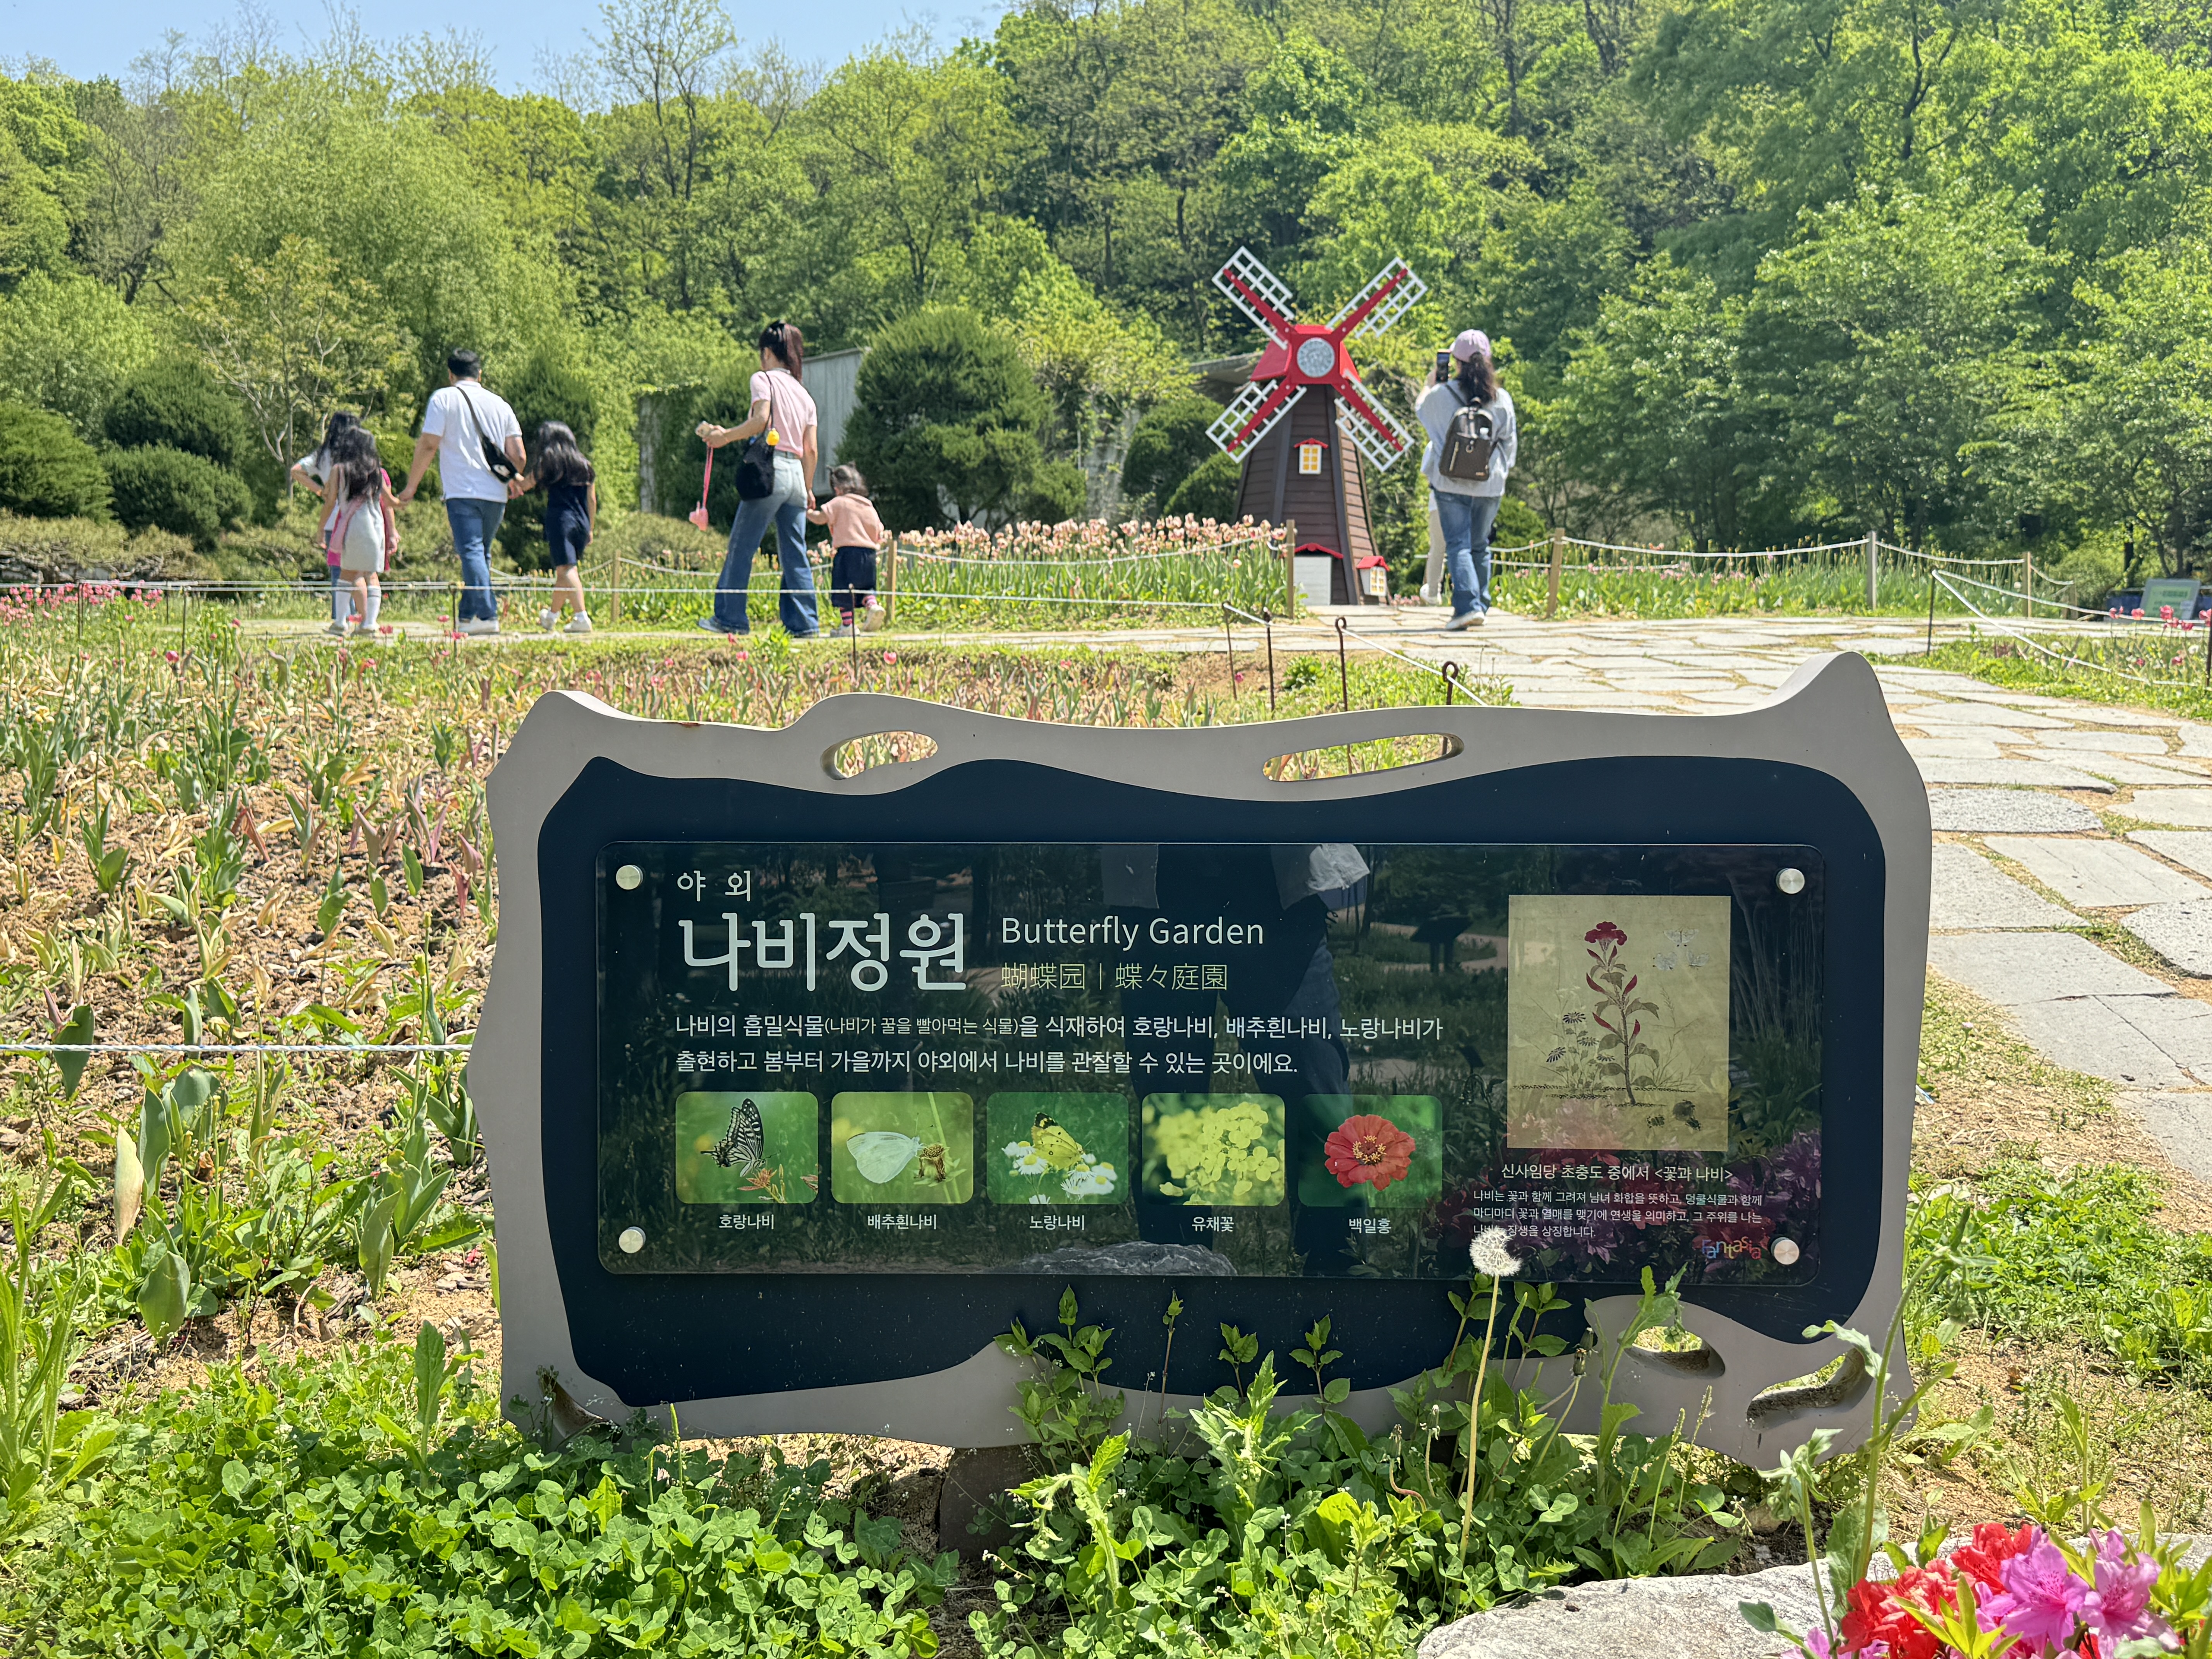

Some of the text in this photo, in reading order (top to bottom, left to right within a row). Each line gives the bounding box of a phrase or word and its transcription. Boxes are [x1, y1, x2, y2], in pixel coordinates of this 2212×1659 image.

[1003, 915, 1263, 951] Butterfly Garden
[678, 912, 967, 991] 나비정원
[677, 1015, 735, 1037] 나비의
[881, 1018, 912, 1034] 꿀을
[917, 1017, 978, 1034] 빨아먹는
[1046, 1015, 1124, 1038] 식재하여
[1132, 1016, 1218, 1039] 호랑나비,
[1225, 1015, 1331, 1039] 배추흰나비,
[1340, 1017, 1443, 1040] 노랑나비가
[676, 1050, 1297, 1074] 출현하고 봄부터 가을까지 야외에서 나비를 관찰할 수 있는 곳이에요.
[1501, 1164, 1557, 1179] 신사임당
[1561, 1164, 1603, 1180] 초충도
[1607, 1165, 1649, 1181] 중에서
[1474, 1190, 1762, 1206] 나비는 꽃과 함께 그려져 남녀 화합을 뜻하고, 덩쿨식물과 함께
[719, 1214, 774, 1230] 호랑나비
[867, 1214, 936, 1230] 배추흰나비
[1029, 1215, 1084, 1230] 노랑나비
[1474, 1207, 1515, 1219] 마디마디
[1518, 1208, 1539, 1220] 꽃과
[1542, 1208, 1573, 1220] 열매를
[1576, 1209, 1607, 1221] 맺기에
[1645, 1210, 1689, 1222] 의미하고,
[1692, 1212, 1703, 1221] 그
[1706, 1211, 1738, 1223] 주위를
[1741, 1211, 1762, 1223] 나는
[1192, 1216, 1234, 1232] 유채꽃
[1349, 1218, 1391, 1234] 백일홍
[1507, 1224, 1539, 1237] 장생을
[1542, 1225, 1596, 1238] 상징합니다.
[1702, 1236, 1762, 1259] Fantasia
